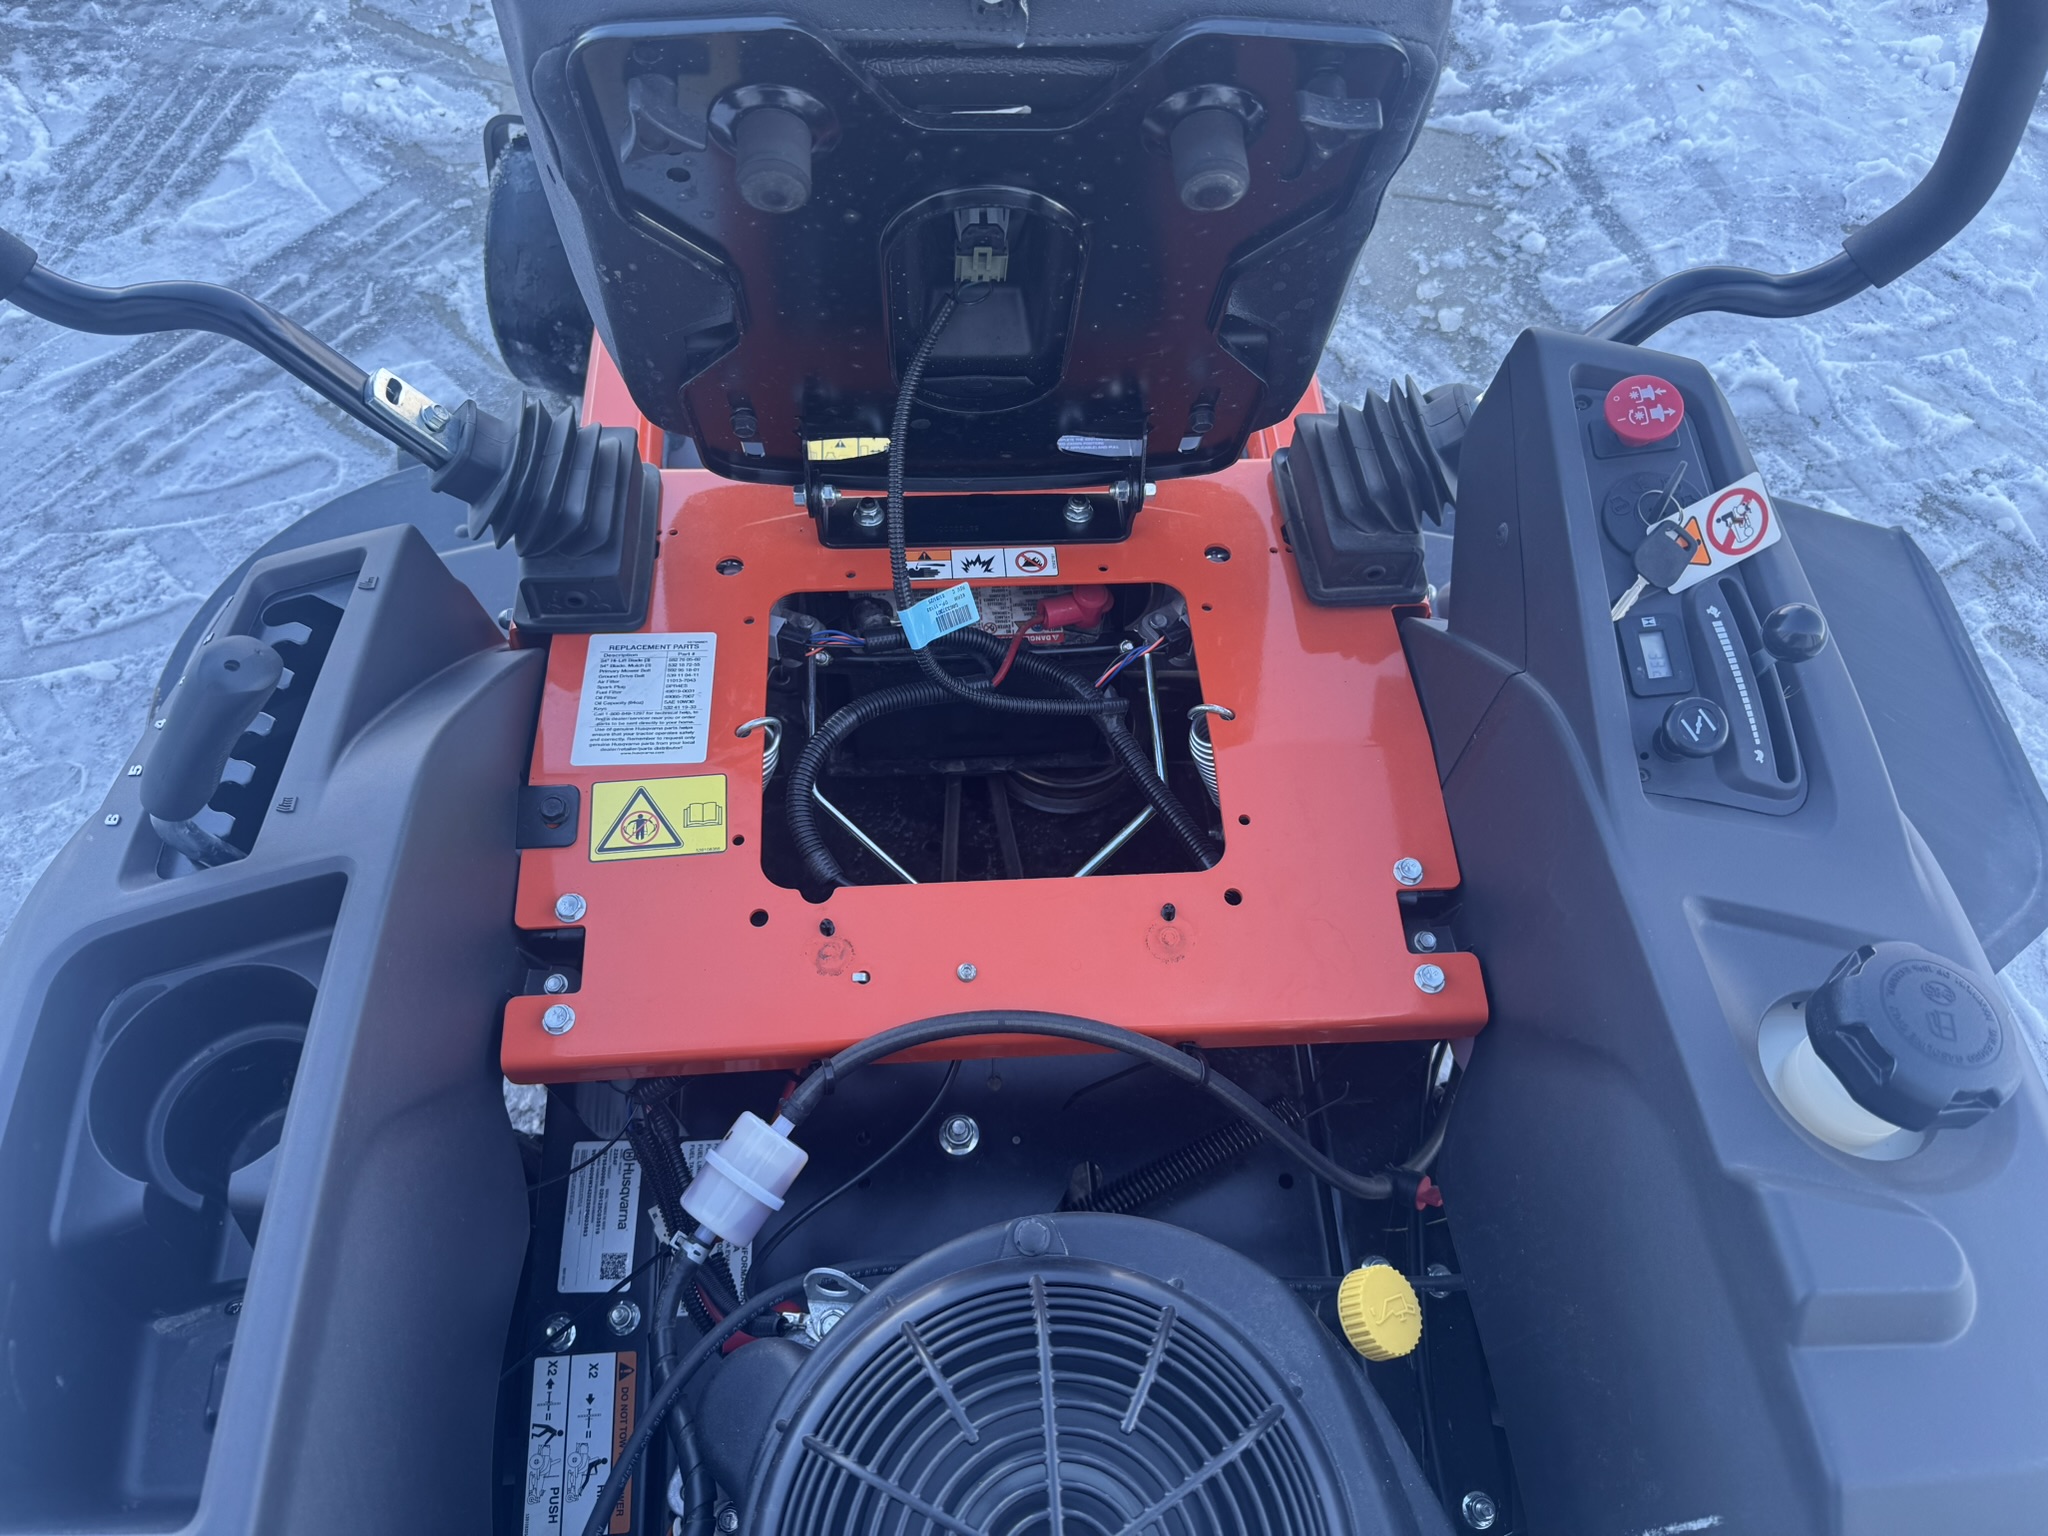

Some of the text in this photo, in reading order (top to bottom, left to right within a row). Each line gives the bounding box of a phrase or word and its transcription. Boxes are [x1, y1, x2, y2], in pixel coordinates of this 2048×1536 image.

[154, 718, 166, 730] 4
[128, 764, 143, 777] 5
[104, 813, 121, 826] 6
[617, 1162, 635, 1230] Husqvarna
[739, 1247, 749, 1303] NFORMATION
[548, 1360, 558, 1376] X2
[589, 1362, 599, 1379] X2
[621, 1386, 629, 1402] DO
[619, 1403, 629, 1424] NOT
[619, 1426, 628, 1448] TOW
[548, 1487, 560, 1524] PUSH
